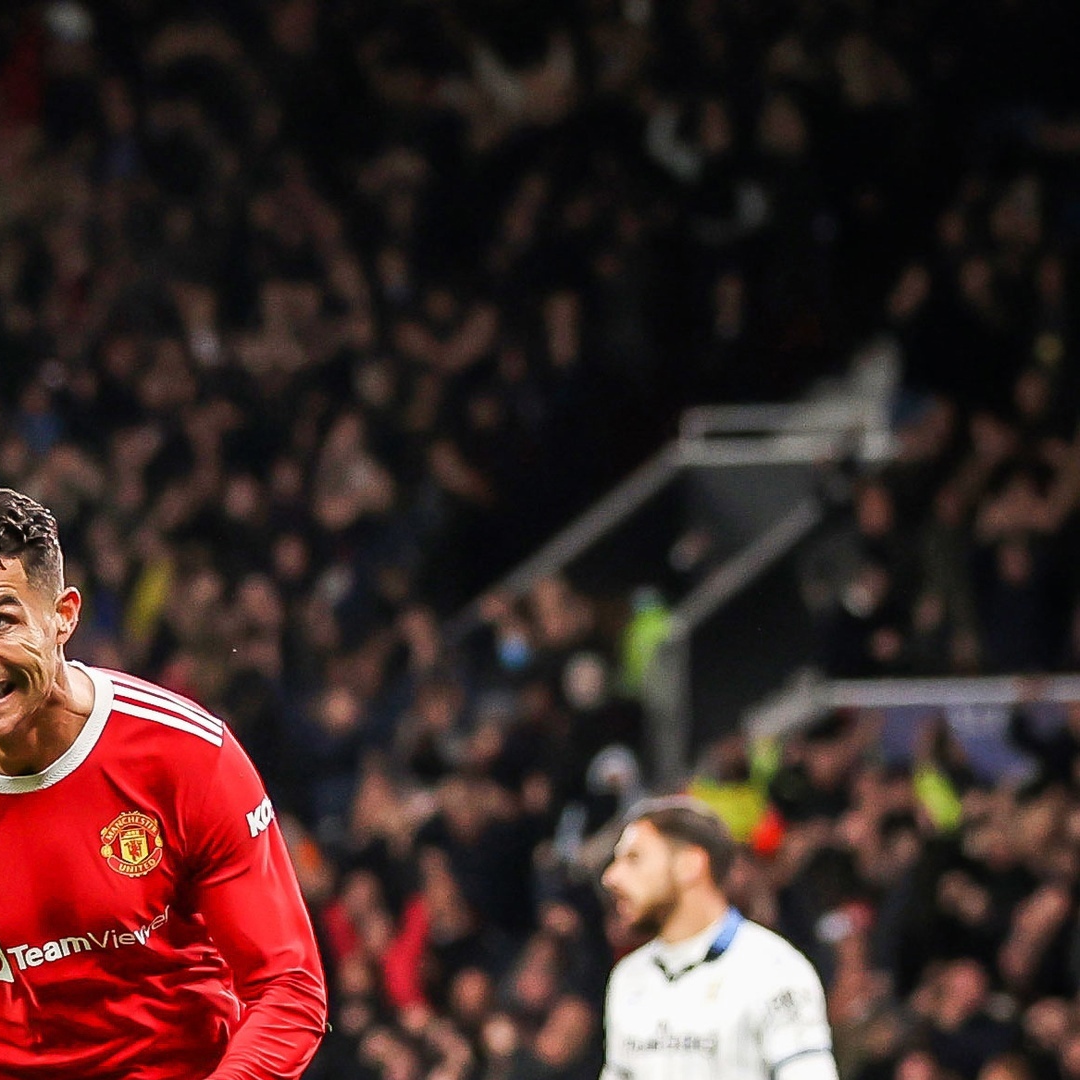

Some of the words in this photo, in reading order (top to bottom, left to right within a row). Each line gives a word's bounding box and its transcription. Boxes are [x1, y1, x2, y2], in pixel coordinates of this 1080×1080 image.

[105, 815, 158, 841] MANCHESTER
[245, 796, 275, 838] KO
[118, 858, 156, 873] UNITED
